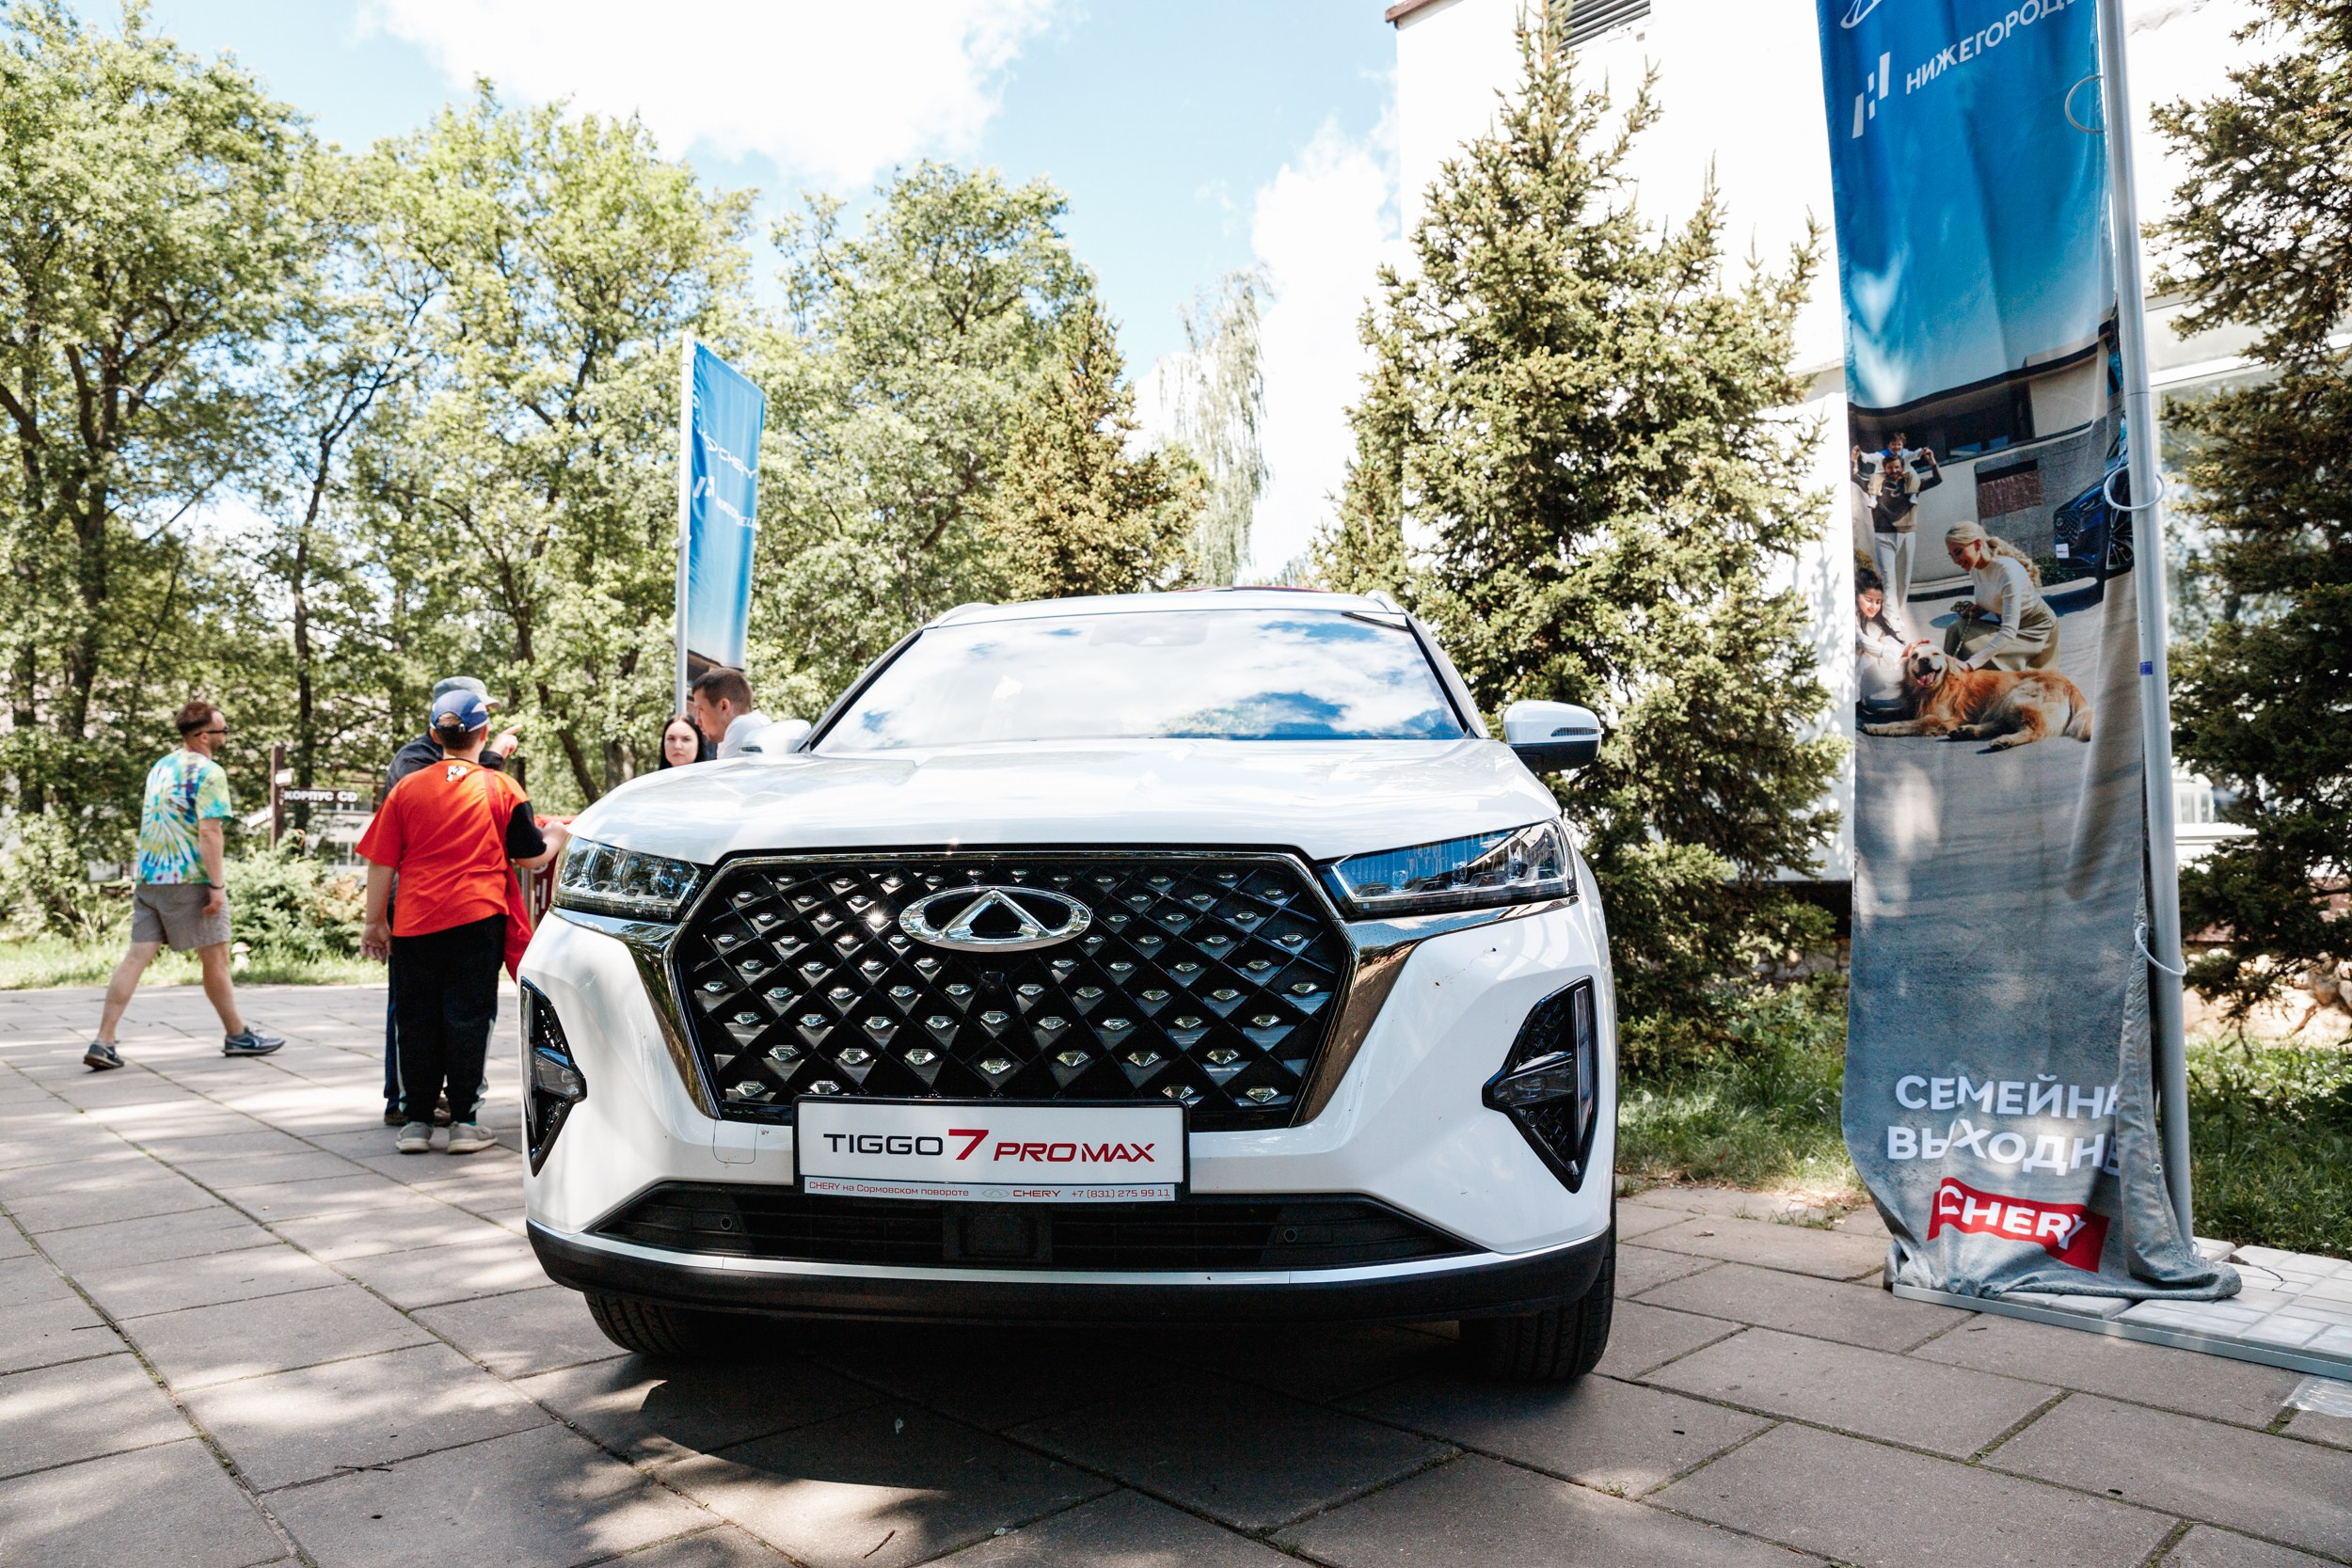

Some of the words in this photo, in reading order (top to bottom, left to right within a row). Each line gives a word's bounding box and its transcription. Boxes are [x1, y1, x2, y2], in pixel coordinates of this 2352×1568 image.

[1906, 0, 2074, 94] НИЖЕГОРОД
[284, 790, 334, 801] КОРПУС
[823, 1133, 944, 1156] TIGGO
[948, 1129, 990, 1161] 7
[993, 1142, 1077, 1163] PRO
[1082, 1143, 1155, 1163] MAX
[809, 1180, 840, 1191] CHERY
[857, 1183, 918, 1196] Сормовском
[921, 1188, 970, 1197] повороте
[1012, 1189, 1062, 1197] CHERY
[1071, 1190, 1085, 1198] +7
[1118, 1189, 1138, 1197] 275
[1141, 1189, 1155, 1197] 99
[1158, 1188, 1171, 1197] 11
[1938, 1184, 2087, 1250] CHERY
